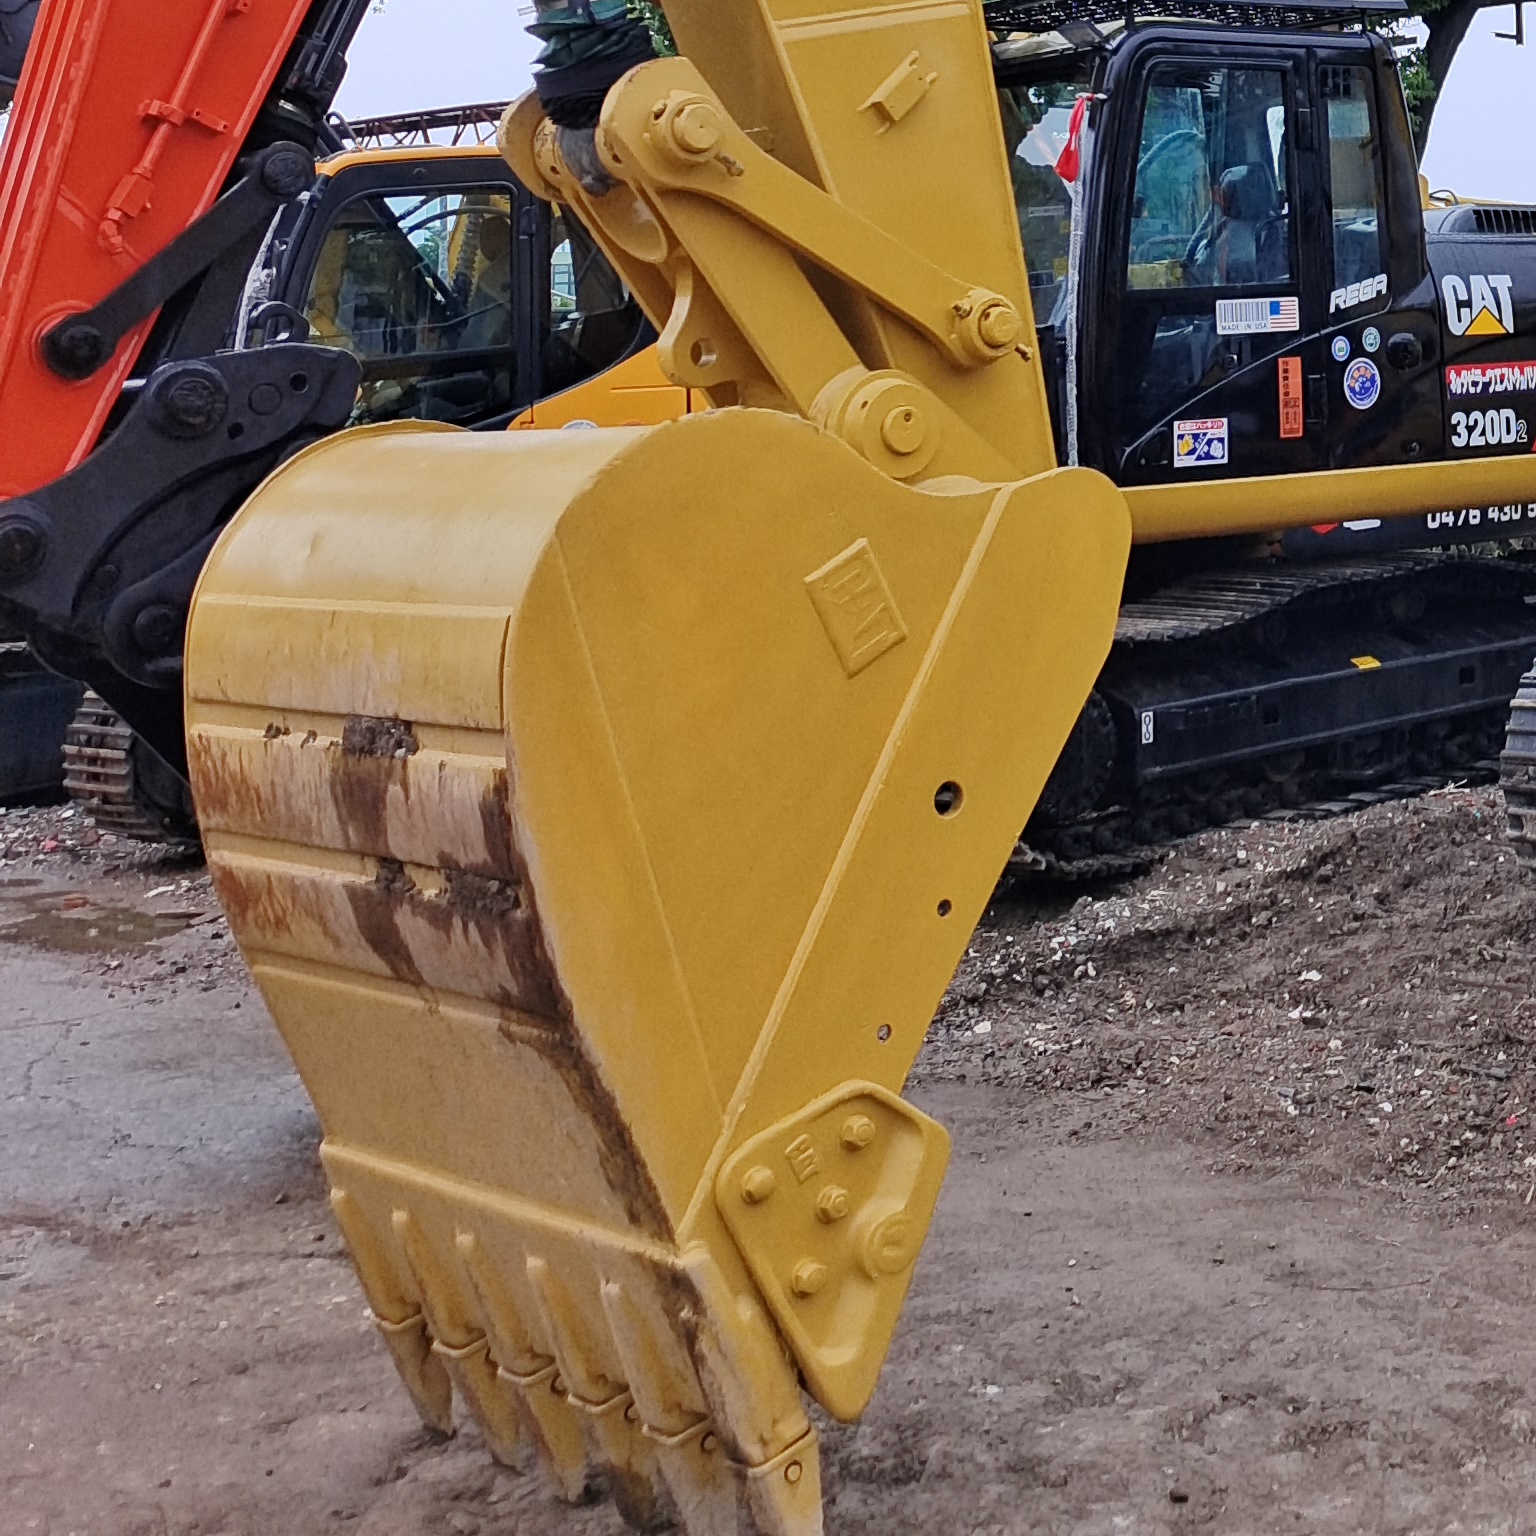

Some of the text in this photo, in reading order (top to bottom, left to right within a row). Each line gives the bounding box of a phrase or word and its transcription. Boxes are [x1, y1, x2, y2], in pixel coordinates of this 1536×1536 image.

[1329, 273, 1388, 314] REGA
[1441, 274, 1515, 336] CAT
[1221, 323, 1240, 331] MADE
[1255, 321, 1268, 330] USA
